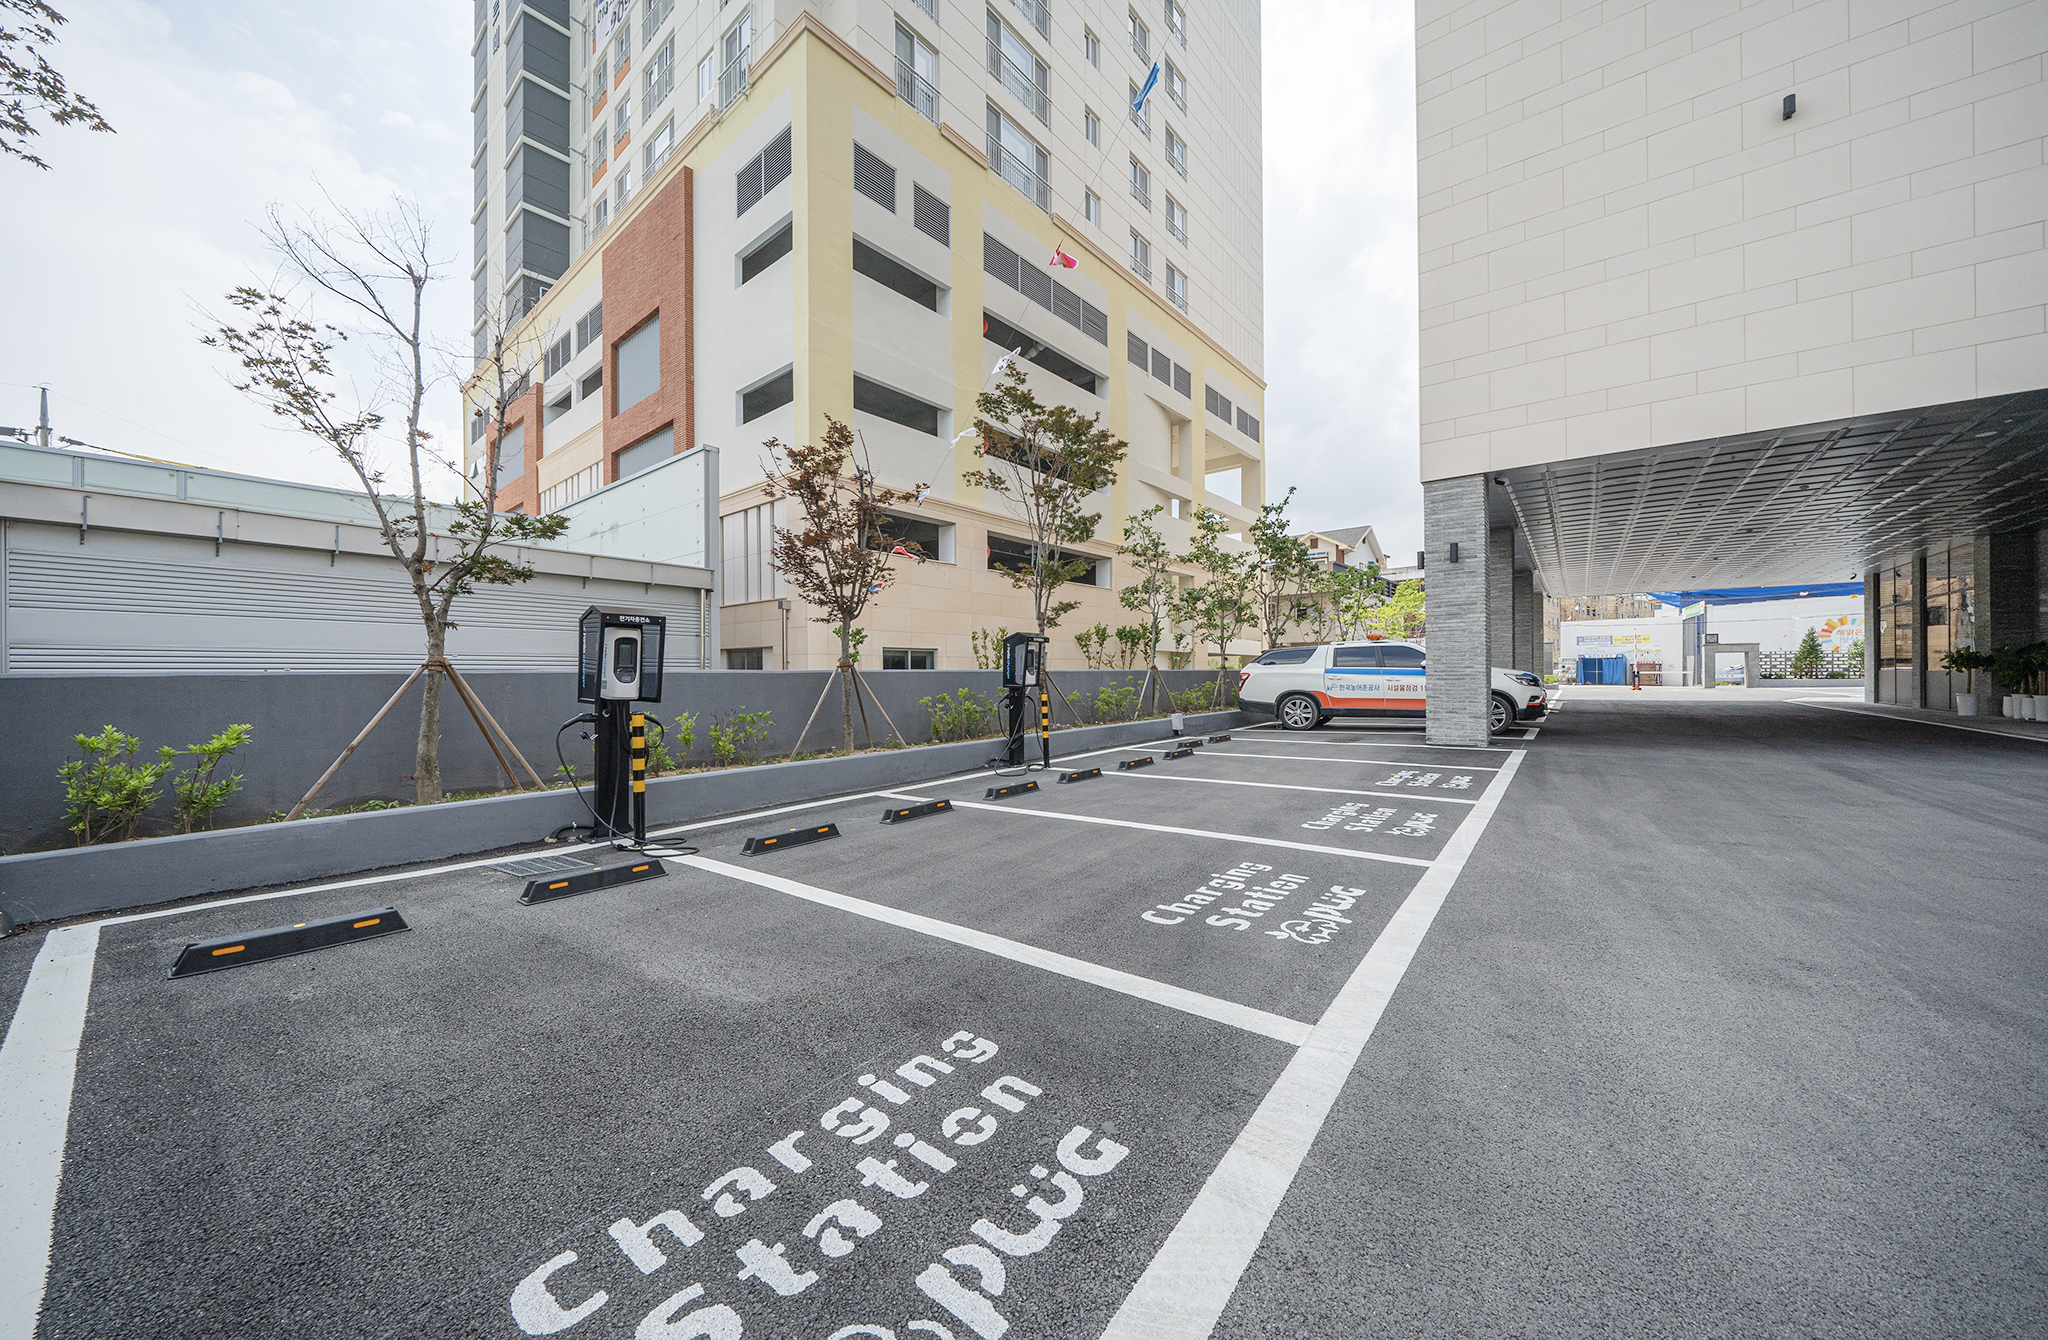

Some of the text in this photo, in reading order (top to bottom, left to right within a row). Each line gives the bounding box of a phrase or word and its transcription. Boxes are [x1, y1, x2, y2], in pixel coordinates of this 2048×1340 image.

[1836, 628, 1863, 637] 해맑은
[1339, 684, 1380, 692] 한국농어촌공사
[1387, 684, 1418, 692] 시설물점검
[1301, 802, 1370, 830] Charging
[1343, 807, 1397, 832] Station
[1140, 861, 1273, 925] Charging
[1205, 873, 1310, 931] Station
[510, 1030, 999, 1336] Charging
[634, 1075, 1043, 1340] Station
